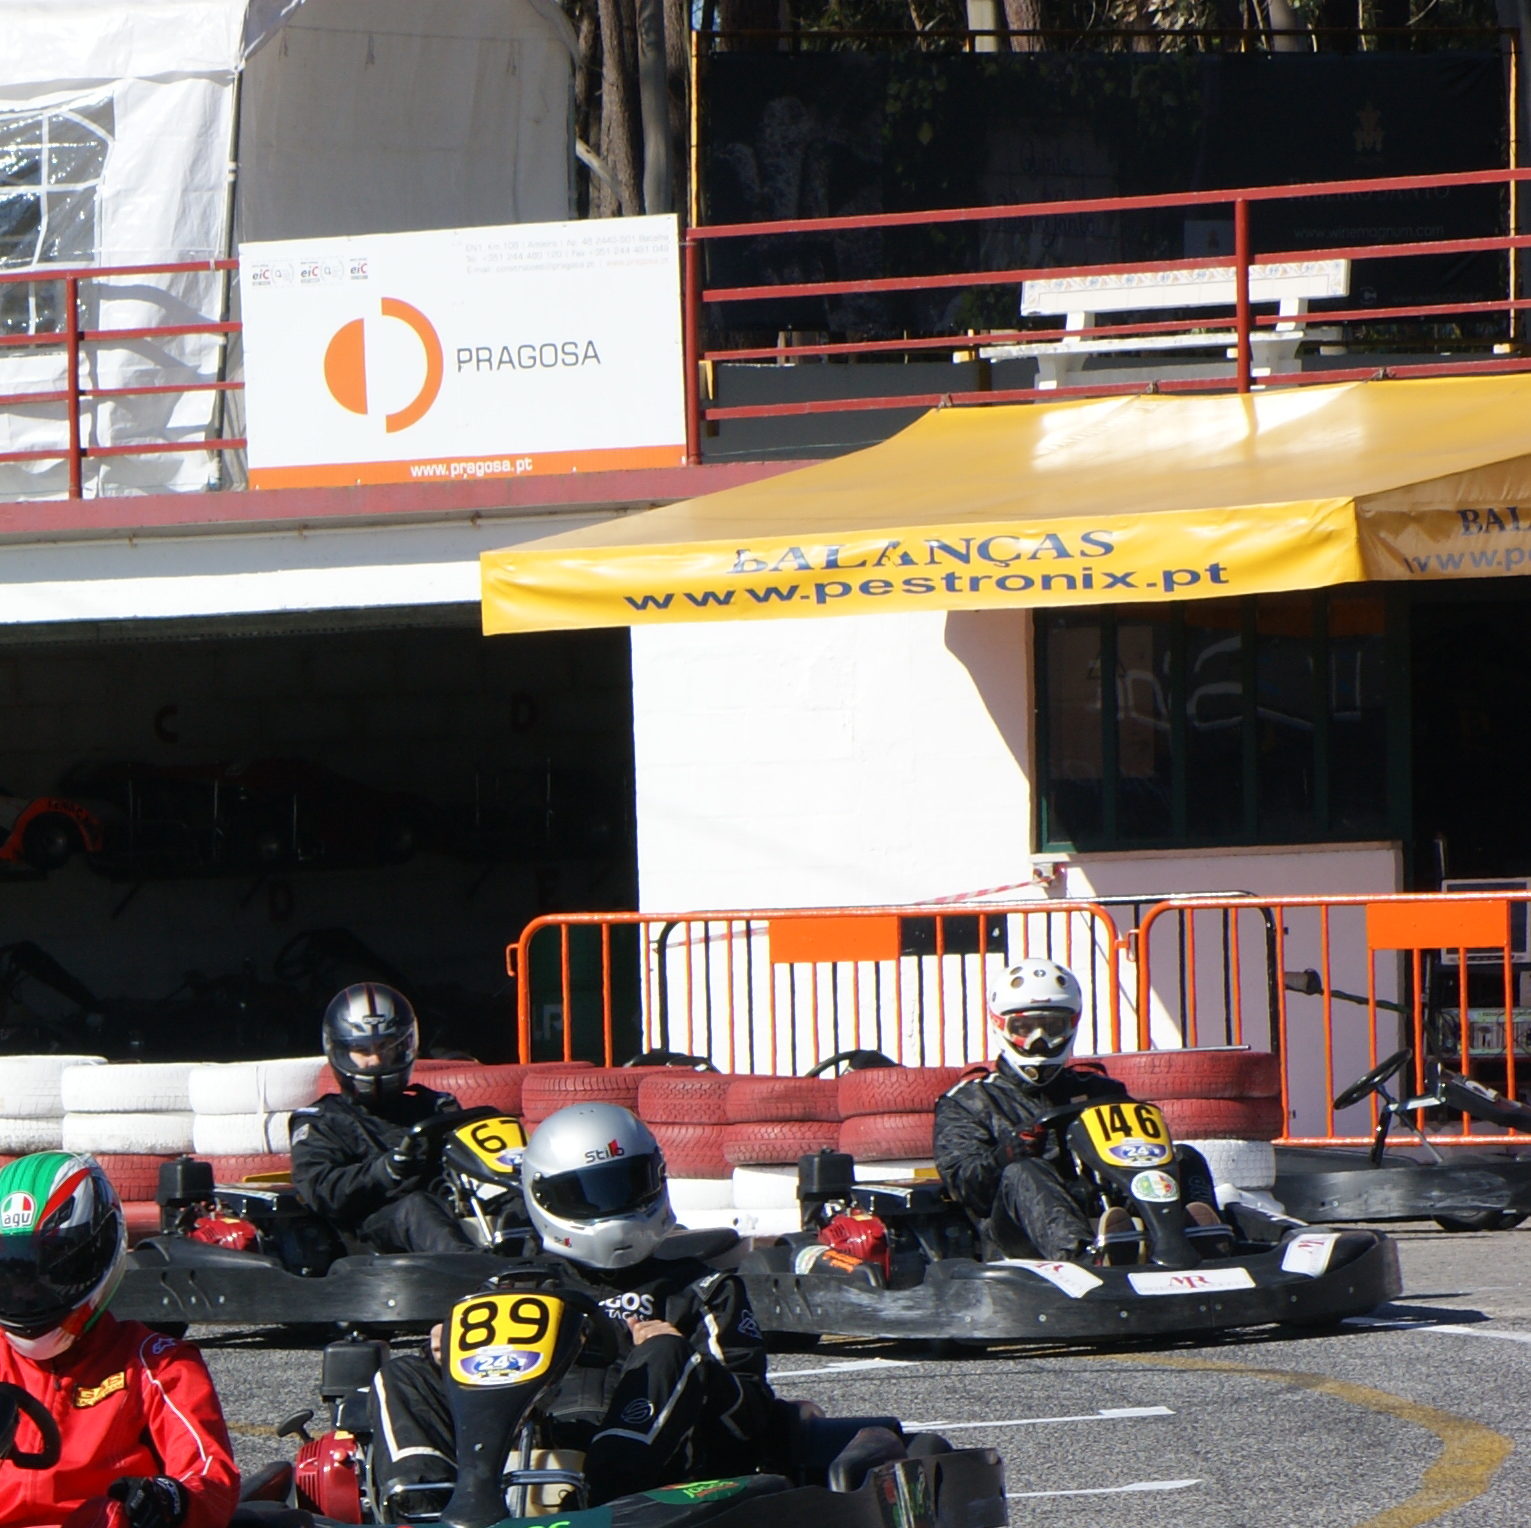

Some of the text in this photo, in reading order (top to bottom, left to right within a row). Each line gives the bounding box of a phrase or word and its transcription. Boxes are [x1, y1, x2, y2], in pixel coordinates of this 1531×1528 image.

[456, 340, 601, 373] PRAGOSA
[410, 456, 533, 478] www.pragosa.pt
[1457, 506, 1531, 536] BAL
[623, 560, 1231, 613] www.pestronix.pt
[471, 1119, 527, 1154] 67
[1095, 1104, 1161, 1142] 146
[585, 1139, 625, 1164] Stilo
[3, 1212, 31, 1227] agv
[459, 1297, 550, 1352] 89
